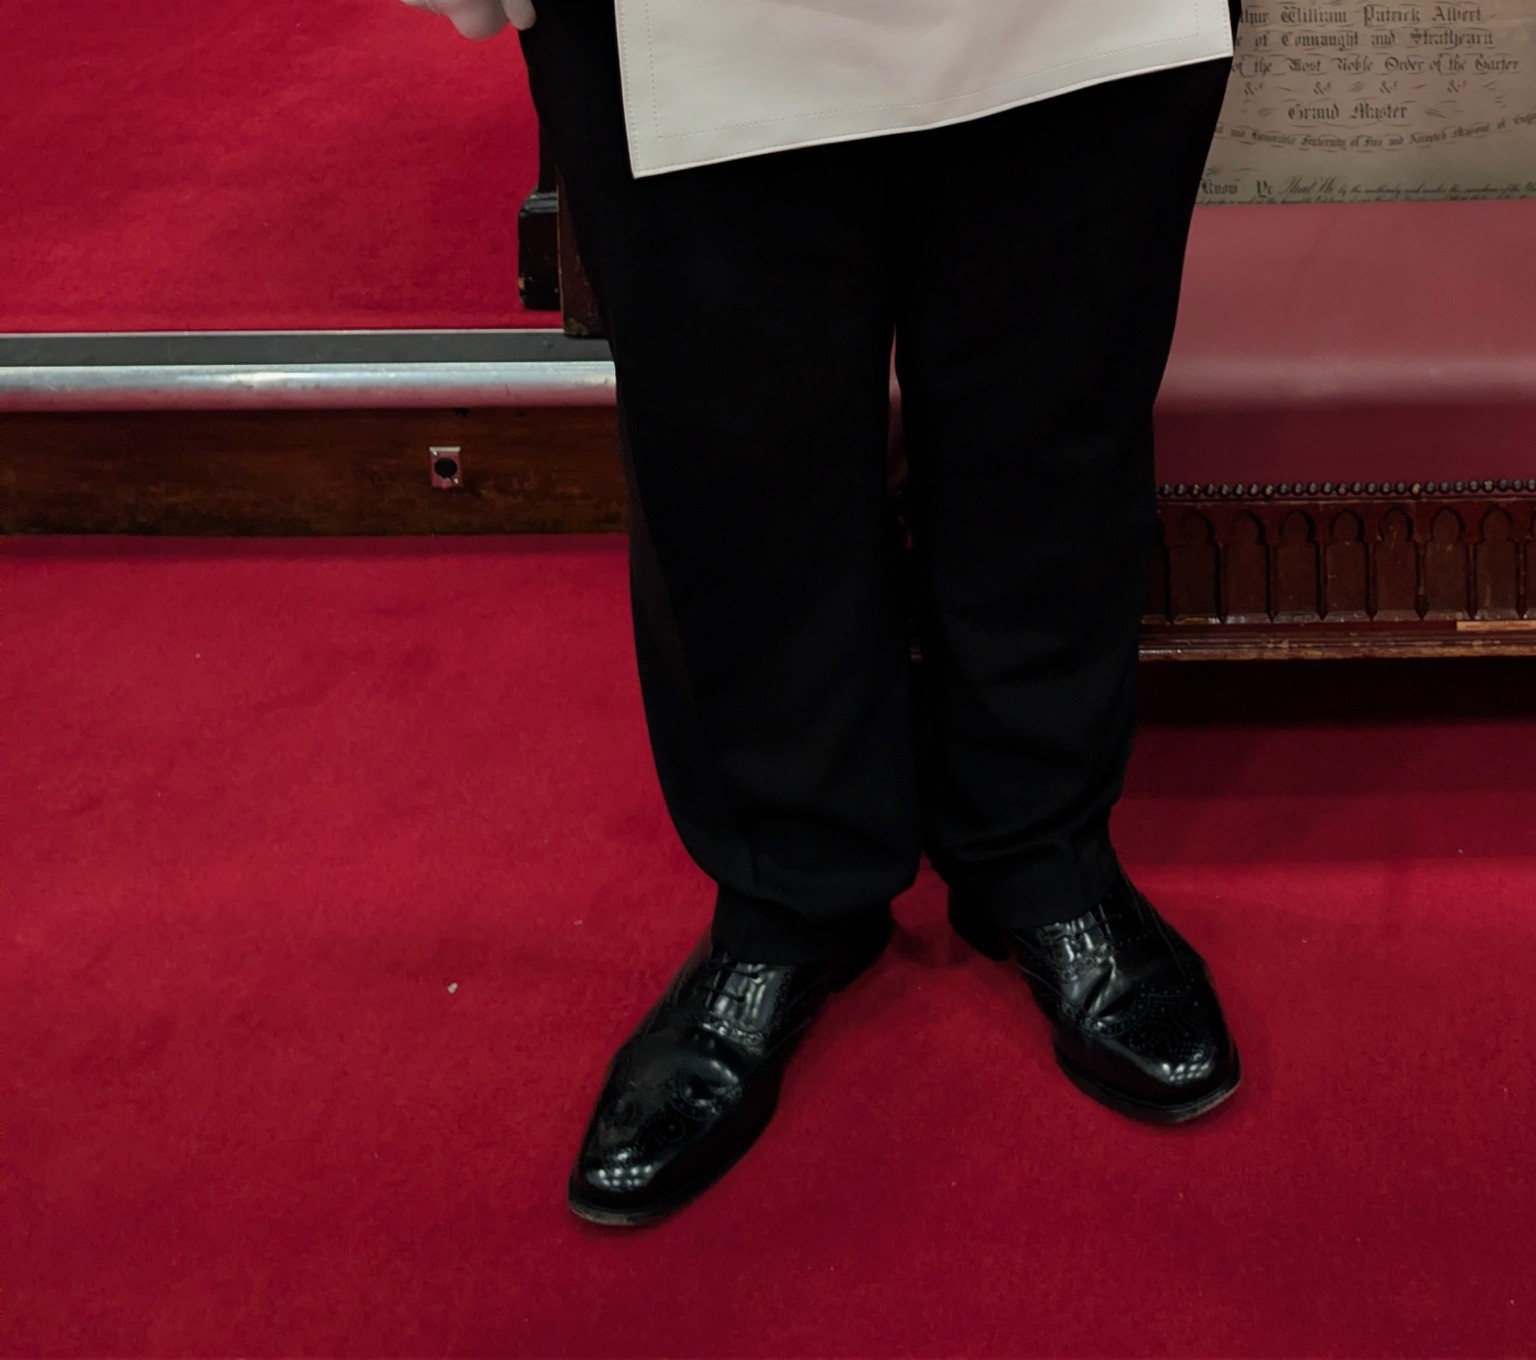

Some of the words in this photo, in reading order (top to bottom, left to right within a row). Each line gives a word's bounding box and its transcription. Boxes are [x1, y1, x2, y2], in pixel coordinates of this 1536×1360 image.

[1281, 6, 1347, 24] William
[1363, 6, 1420, 26] Patrick
[1432, 5, 1482, 22] Albert
[1288, 103, 1339, 120] Grand
[1351, 103, 1408, 119] Master
